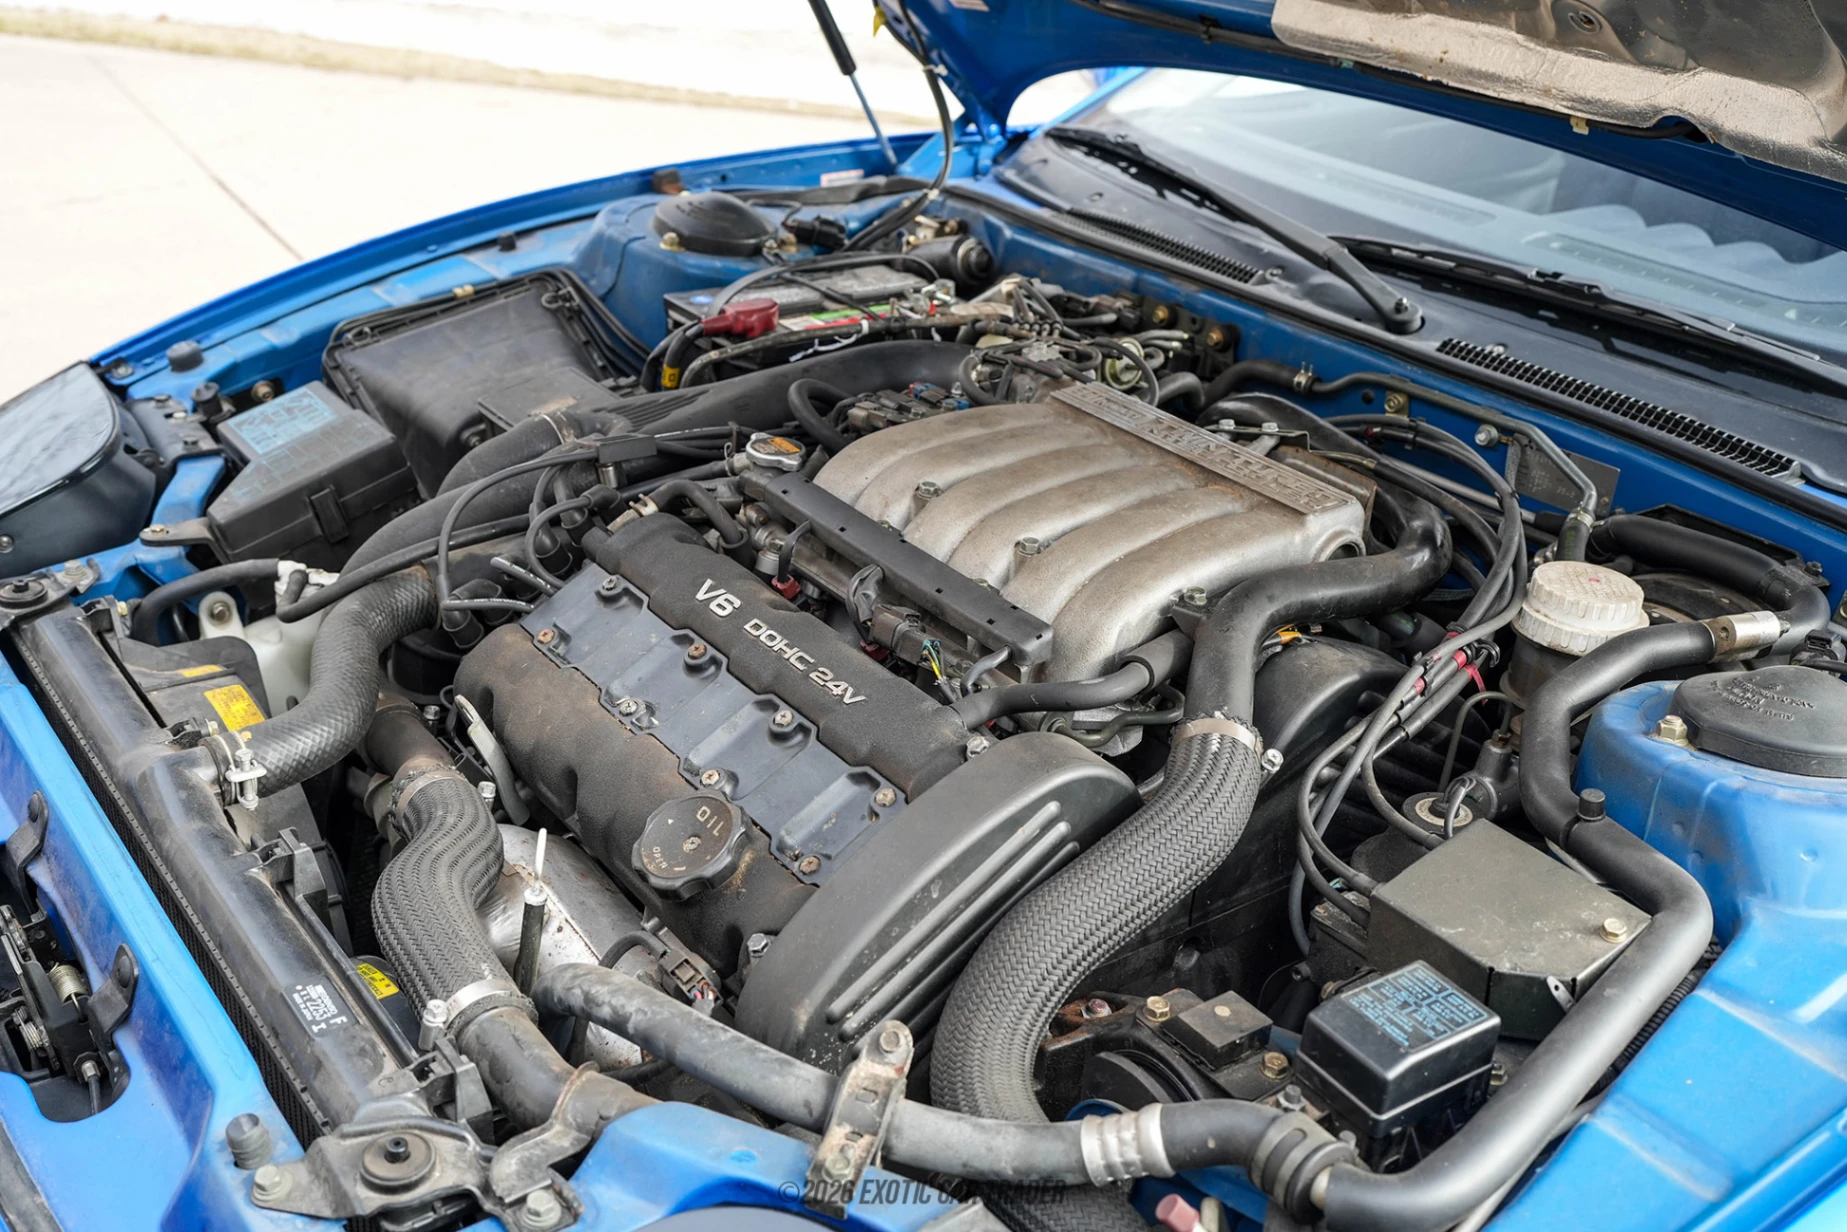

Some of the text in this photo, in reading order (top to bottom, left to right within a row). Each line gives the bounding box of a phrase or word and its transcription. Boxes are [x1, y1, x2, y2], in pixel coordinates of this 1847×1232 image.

[695, 579, 866, 705] V6 DOHC 24V
[696, 805, 724, 836] OIL
[652, 846, 668, 868] OPEN
